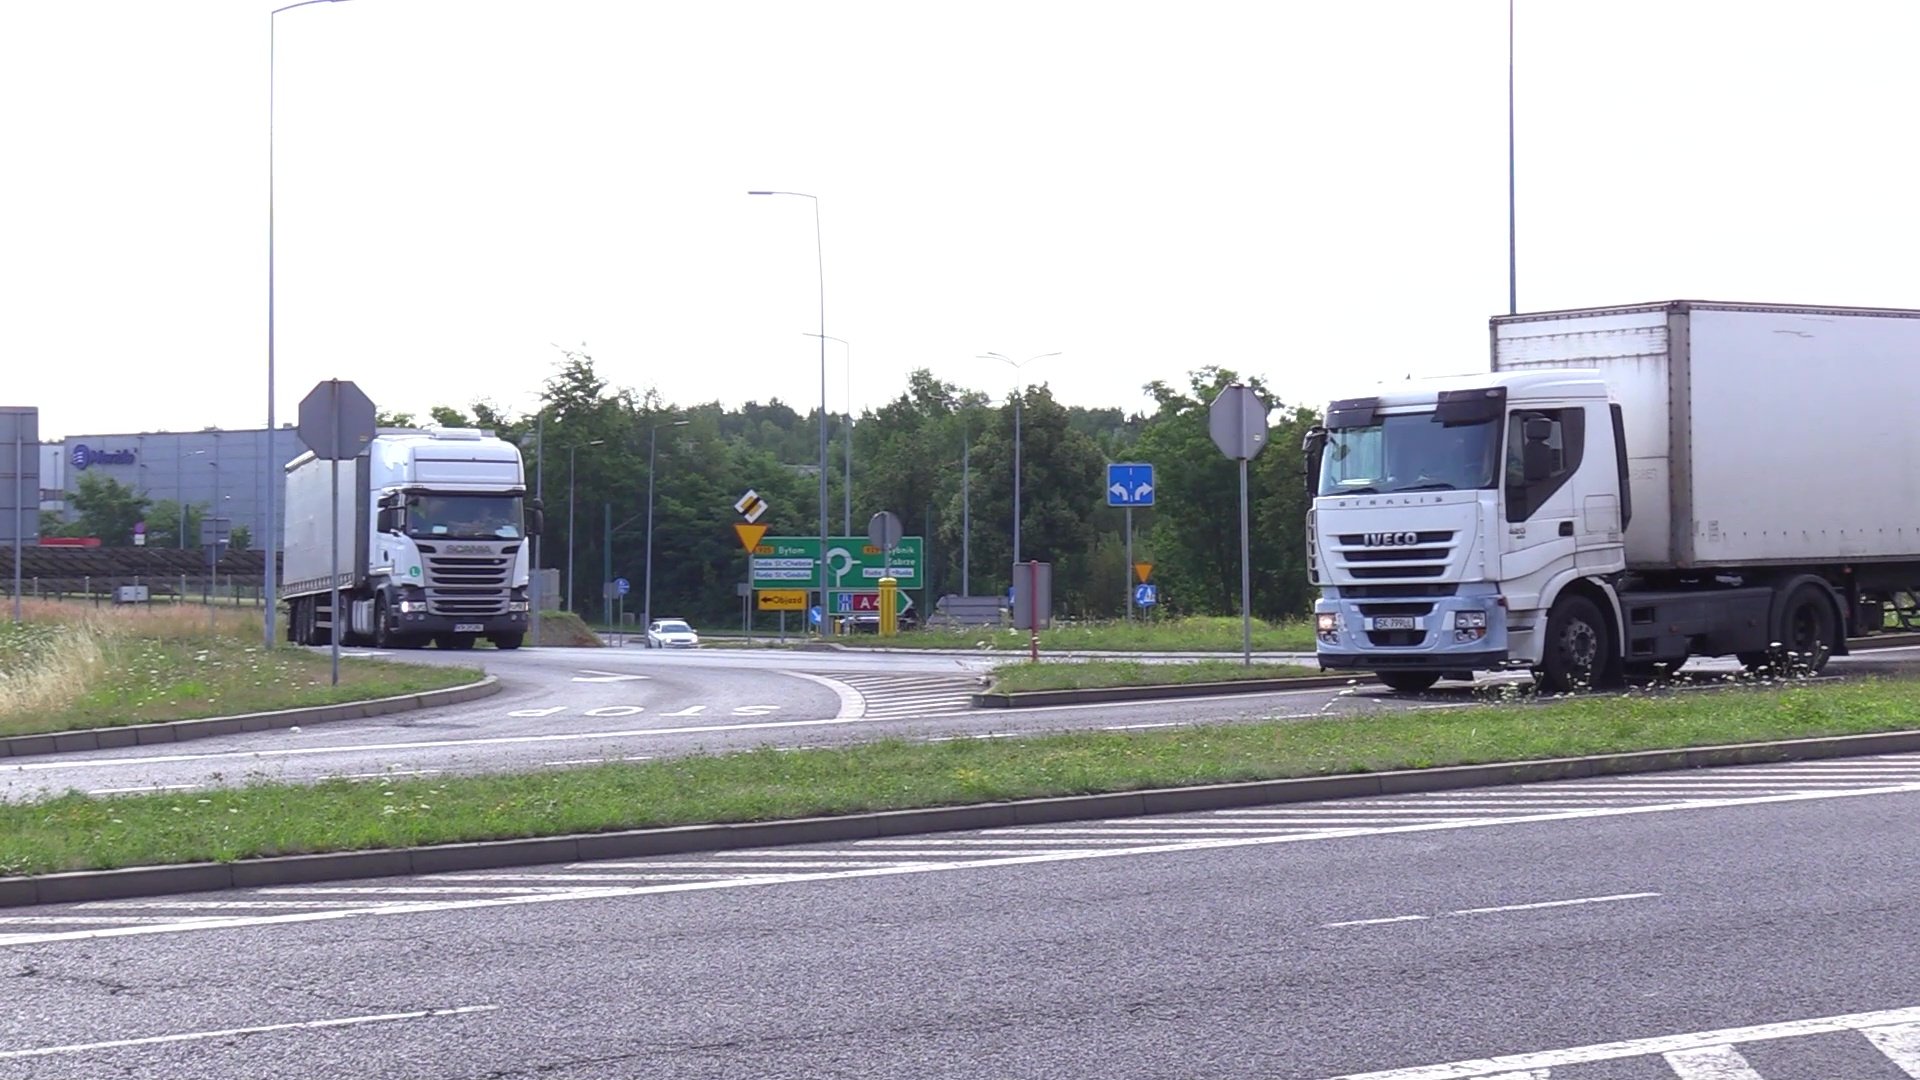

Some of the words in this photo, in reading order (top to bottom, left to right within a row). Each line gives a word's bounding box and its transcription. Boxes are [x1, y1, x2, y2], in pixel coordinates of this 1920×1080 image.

[1339, 496, 1443, 507] STRALIS
[1363, 531, 1418, 547] IVECO
[445, 544, 492, 553] SCANIA
[778, 546, 805, 556] Bytom
[773, 595, 802, 605] Objazd
[507, 705, 781, 717] STOP
